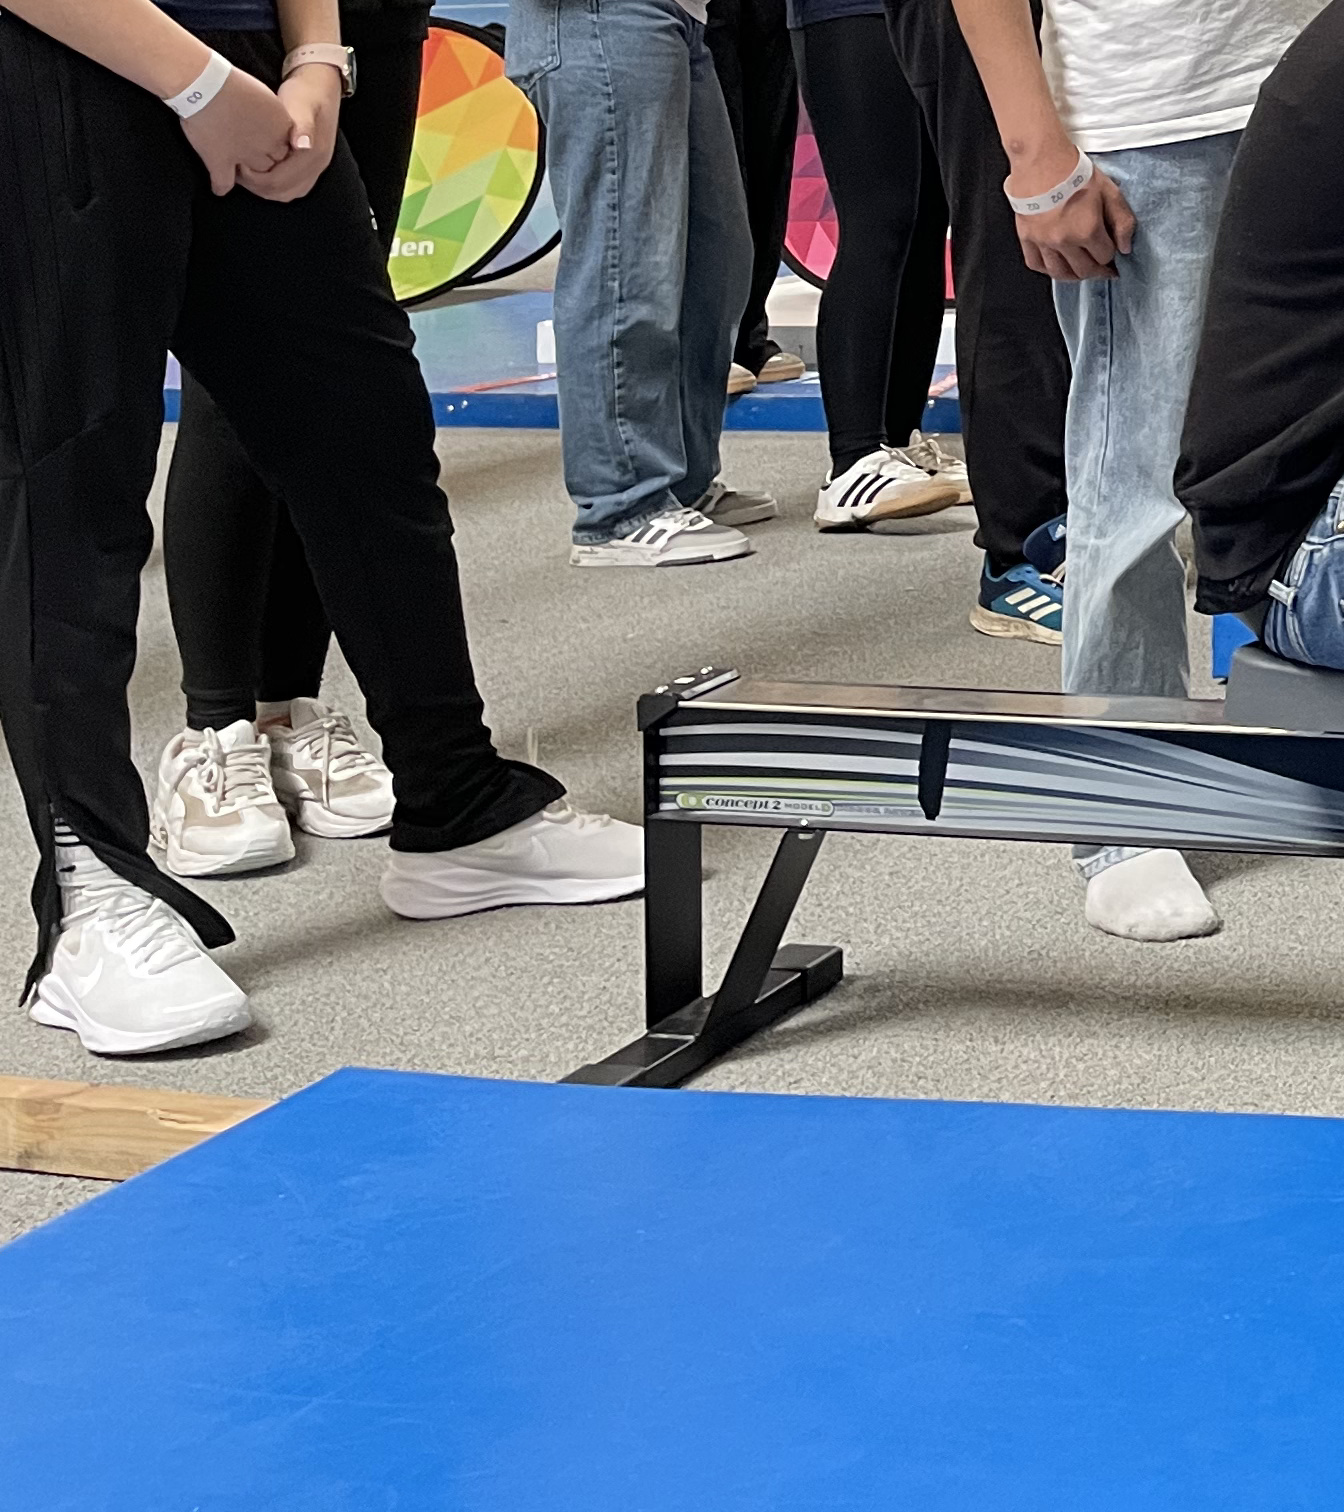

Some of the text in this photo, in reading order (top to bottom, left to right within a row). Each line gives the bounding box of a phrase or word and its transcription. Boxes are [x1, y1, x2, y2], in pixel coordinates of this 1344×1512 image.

[705, 796, 769, 810] concept
[772, 800, 782, 811] 2
[784, 802, 820, 812] MODEL
